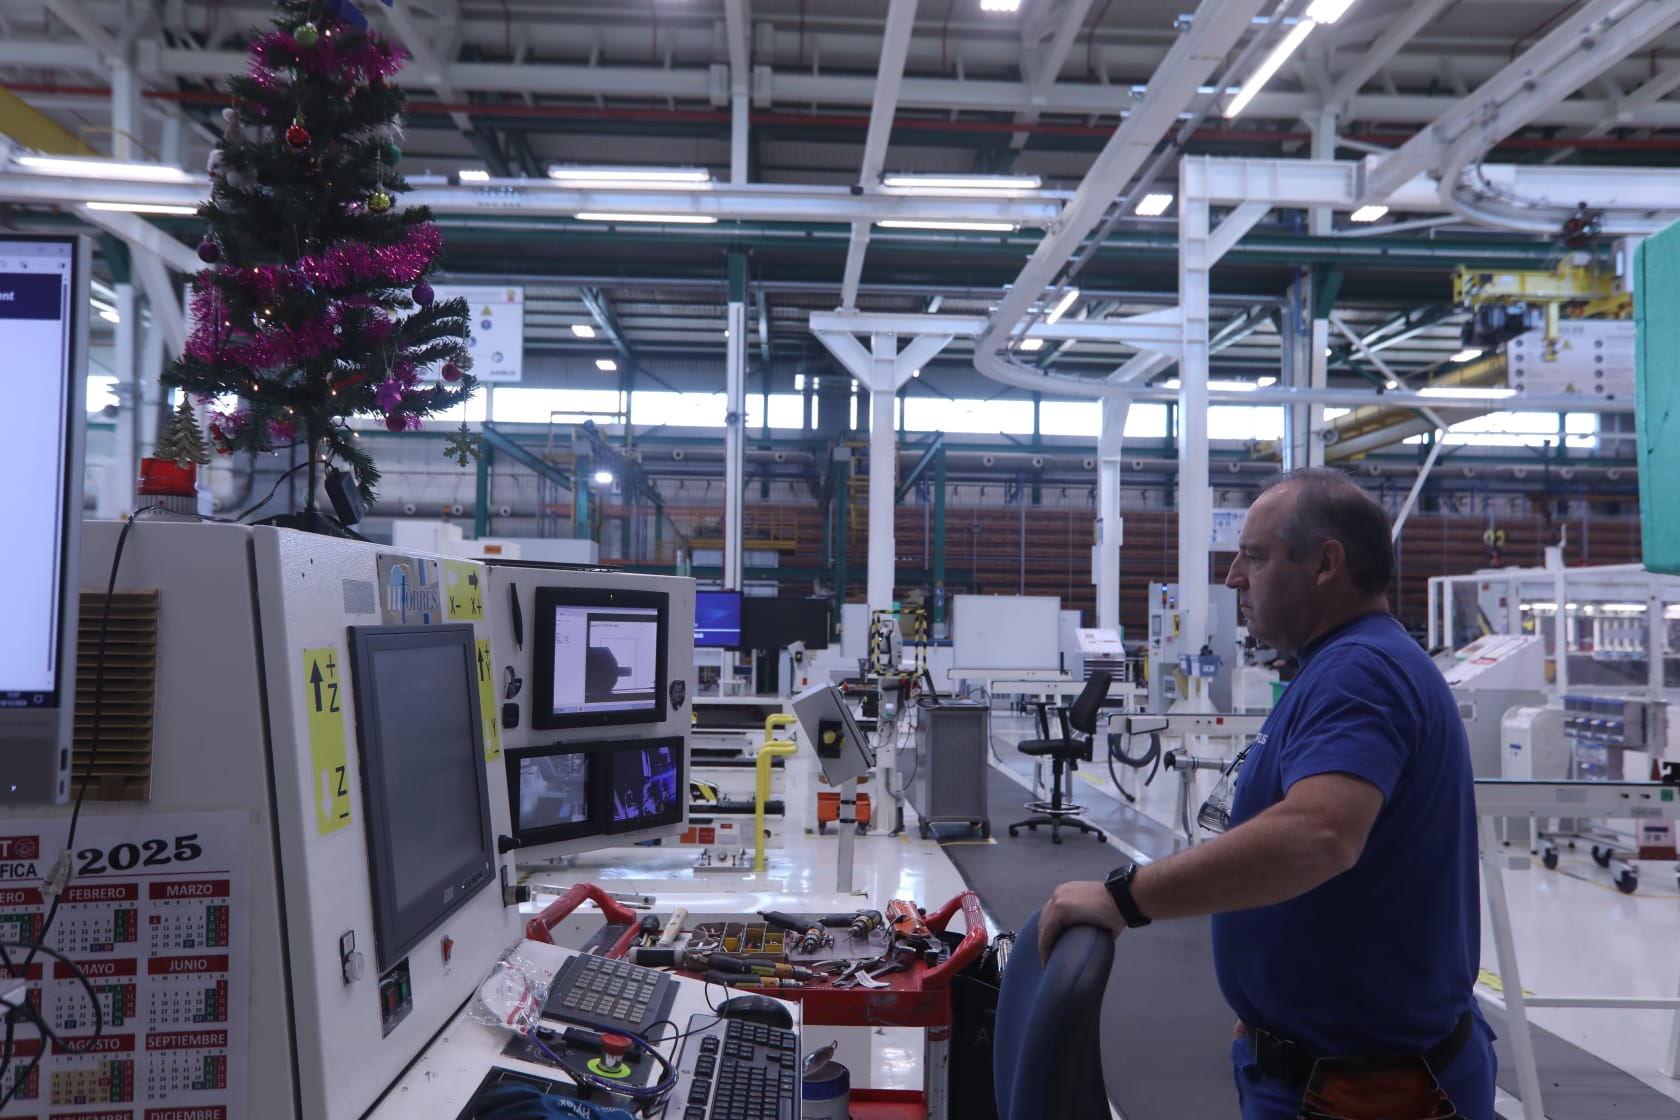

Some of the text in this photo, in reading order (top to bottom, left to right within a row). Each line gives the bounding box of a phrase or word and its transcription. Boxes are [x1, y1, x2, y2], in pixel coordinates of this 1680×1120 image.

[328, 683, 340, 713] Z
[335, 765, 348, 796] Z
[77, 834, 202, 876] 2025
[0, 863, 37, 878] FICA
[69, 887, 126, 900] FEBRERO
[166, 884, 213, 896] MARZO
[77, 963, 115, 975] MAYO
[169, 959, 207, 971] JUNIO
[148, 1033, 225, 1047] SEPTIEMBRE
[151, 1109, 220, 1120] DICIEMBRE
